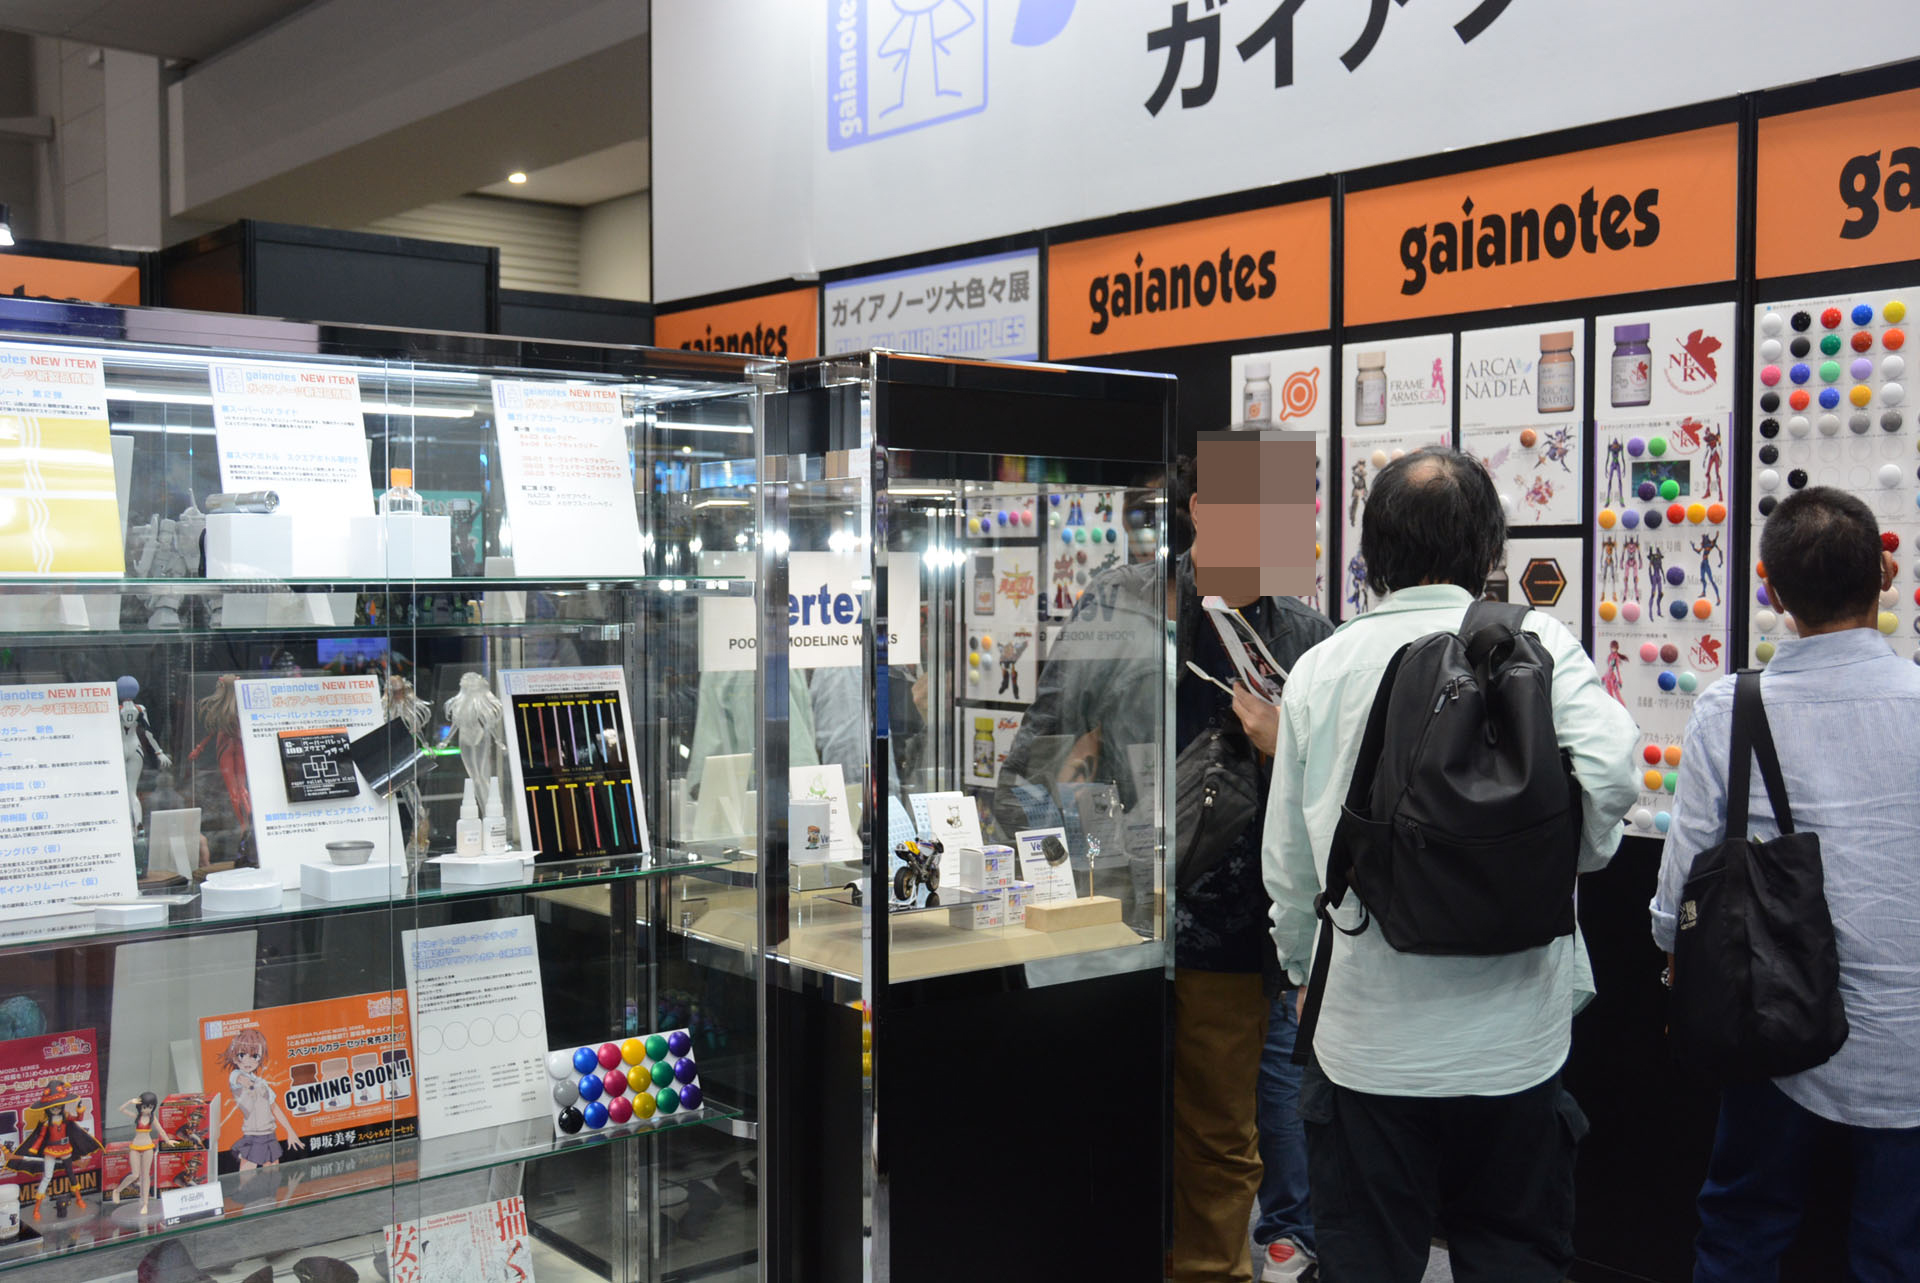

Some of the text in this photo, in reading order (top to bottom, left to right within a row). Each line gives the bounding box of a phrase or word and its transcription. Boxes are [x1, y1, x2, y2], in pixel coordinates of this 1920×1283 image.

[1400, 186, 1660, 295] gaianotes
[1089, 246, 1277, 334] gaianotes
[832, 270, 1030, 328] ガイアノーツ大色々展
[30, 355, 61, 367] NEW
[65, 358, 97, 368] ITEM
[1466, 358, 1517, 379] ARCA
[301, 373, 326, 384] NEW
[329, 376, 356, 385] ITEM
[1391, 379, 1424, 391] FRAME
[570, 389, 591, 398] NEW
[593, 390, 617, 399] ITEM
[1391, 389, 1442, 402] ARMS GIRL
[1465, 379, 1531, 400] NADEA
[322, 681, 346, 690] NEW
[349, 680, 375, 689] ITEM
[48, 689, 77, 699] NEW
[81, 687, 112, 697] ITEM
[285, 1076, 351, 1110] COMING
